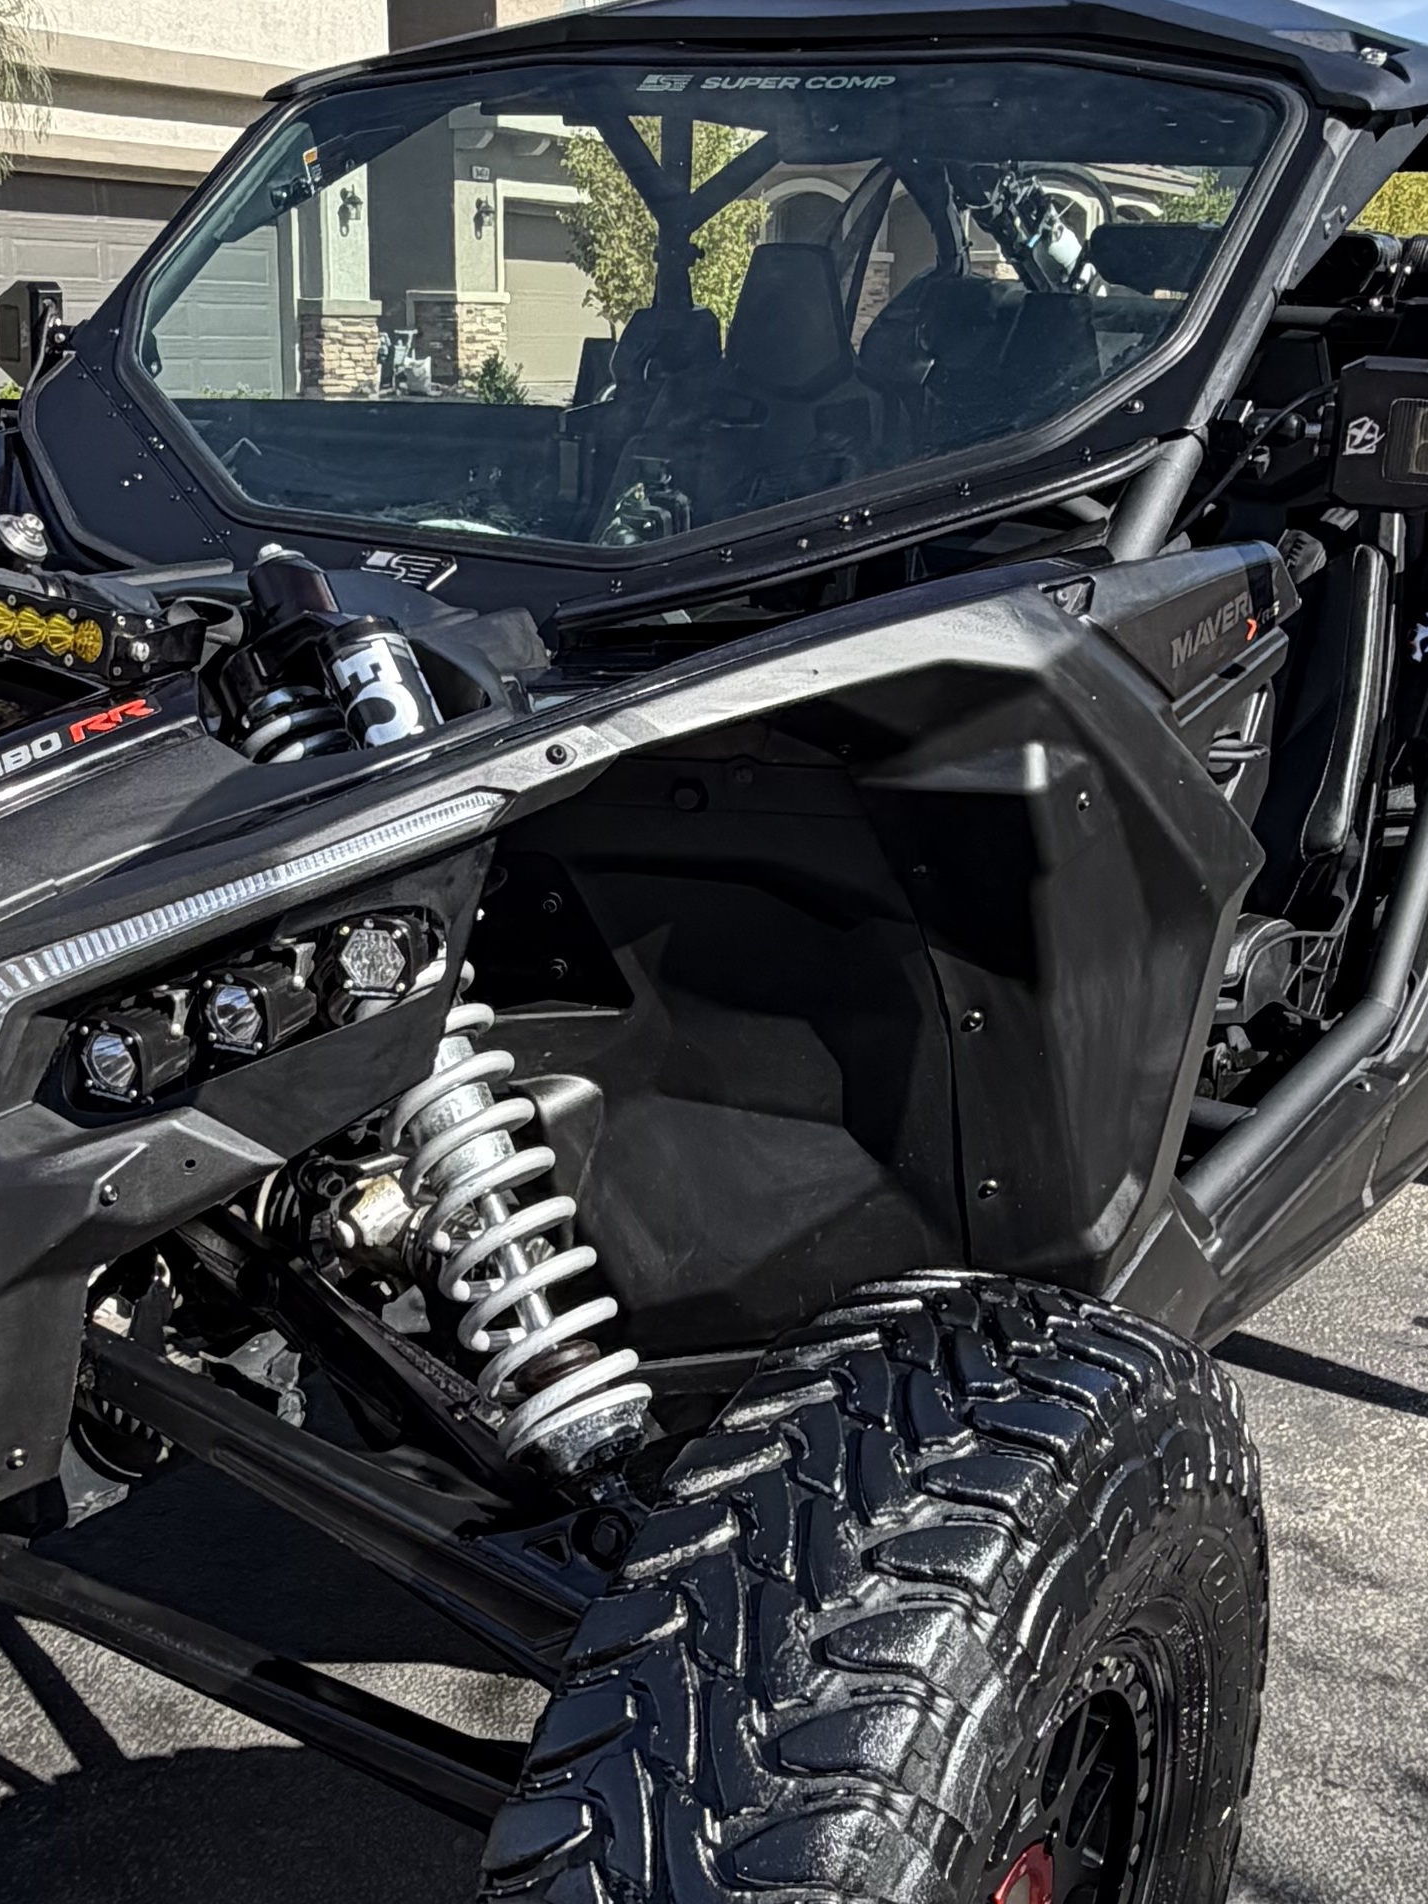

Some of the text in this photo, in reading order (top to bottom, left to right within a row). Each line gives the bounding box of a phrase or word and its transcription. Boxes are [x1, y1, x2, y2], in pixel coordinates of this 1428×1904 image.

[700, 76, 801, 90] SUPER
[805, 75, 896, 90] COMP
[1171, 591, 1253, 669] MAVER
[68, 698, 155, 744] RR
[332, 638, 425, 747] FO
